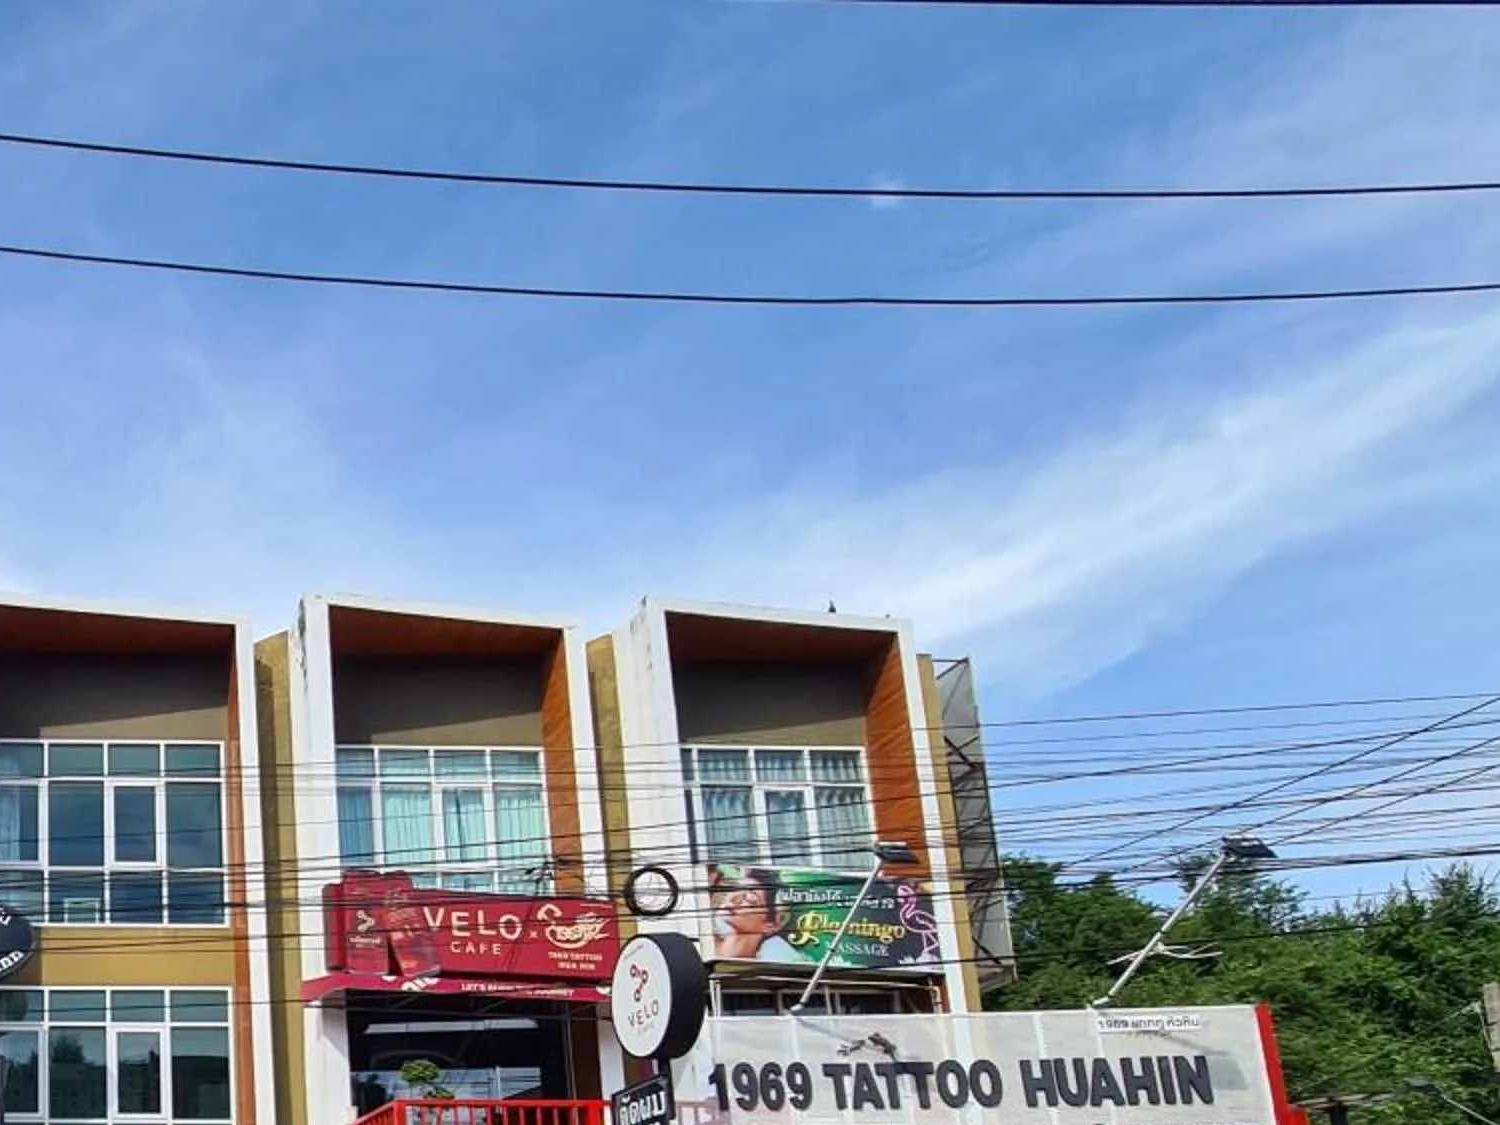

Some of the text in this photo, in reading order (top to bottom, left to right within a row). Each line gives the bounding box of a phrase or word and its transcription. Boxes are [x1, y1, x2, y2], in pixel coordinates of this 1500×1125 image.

[422, 904, 523, 940] VELO
[451, 941, 501, 955] CAFE
[627, 999, 660, 1028] VELO
[708, 1054, 1215, 1113] 1969 TATTOO HUAHIN
